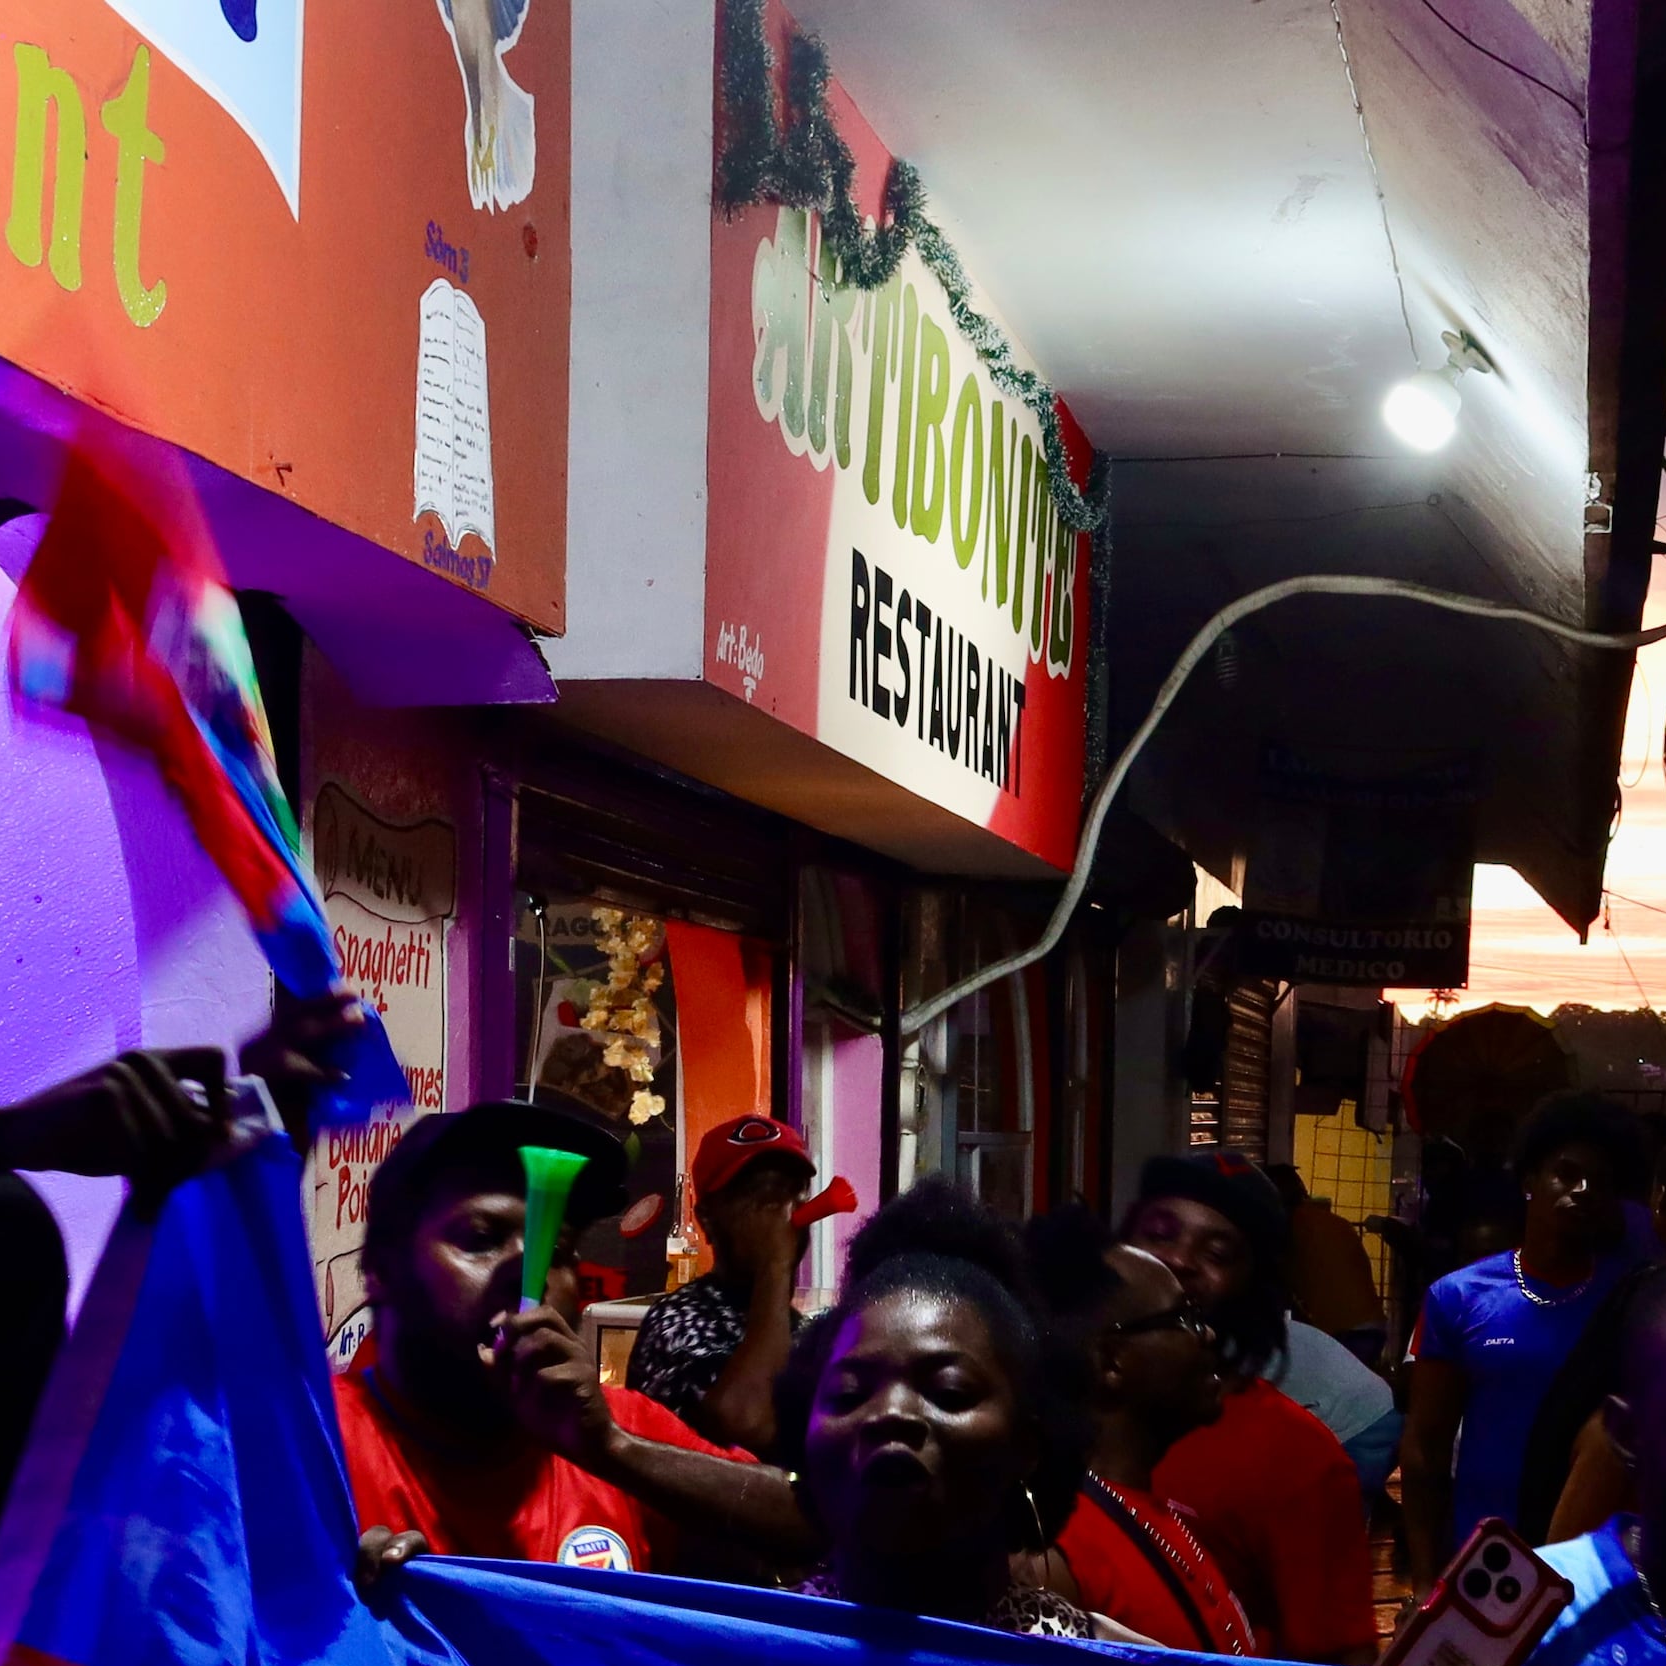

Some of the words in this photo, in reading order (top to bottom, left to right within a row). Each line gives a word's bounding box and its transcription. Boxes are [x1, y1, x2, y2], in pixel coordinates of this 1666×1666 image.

[849, 546, 1027, 798] RESTAURANT
[346, 826, 424, 907] MENU
[333, 923, 432, 998] Spaghetti
